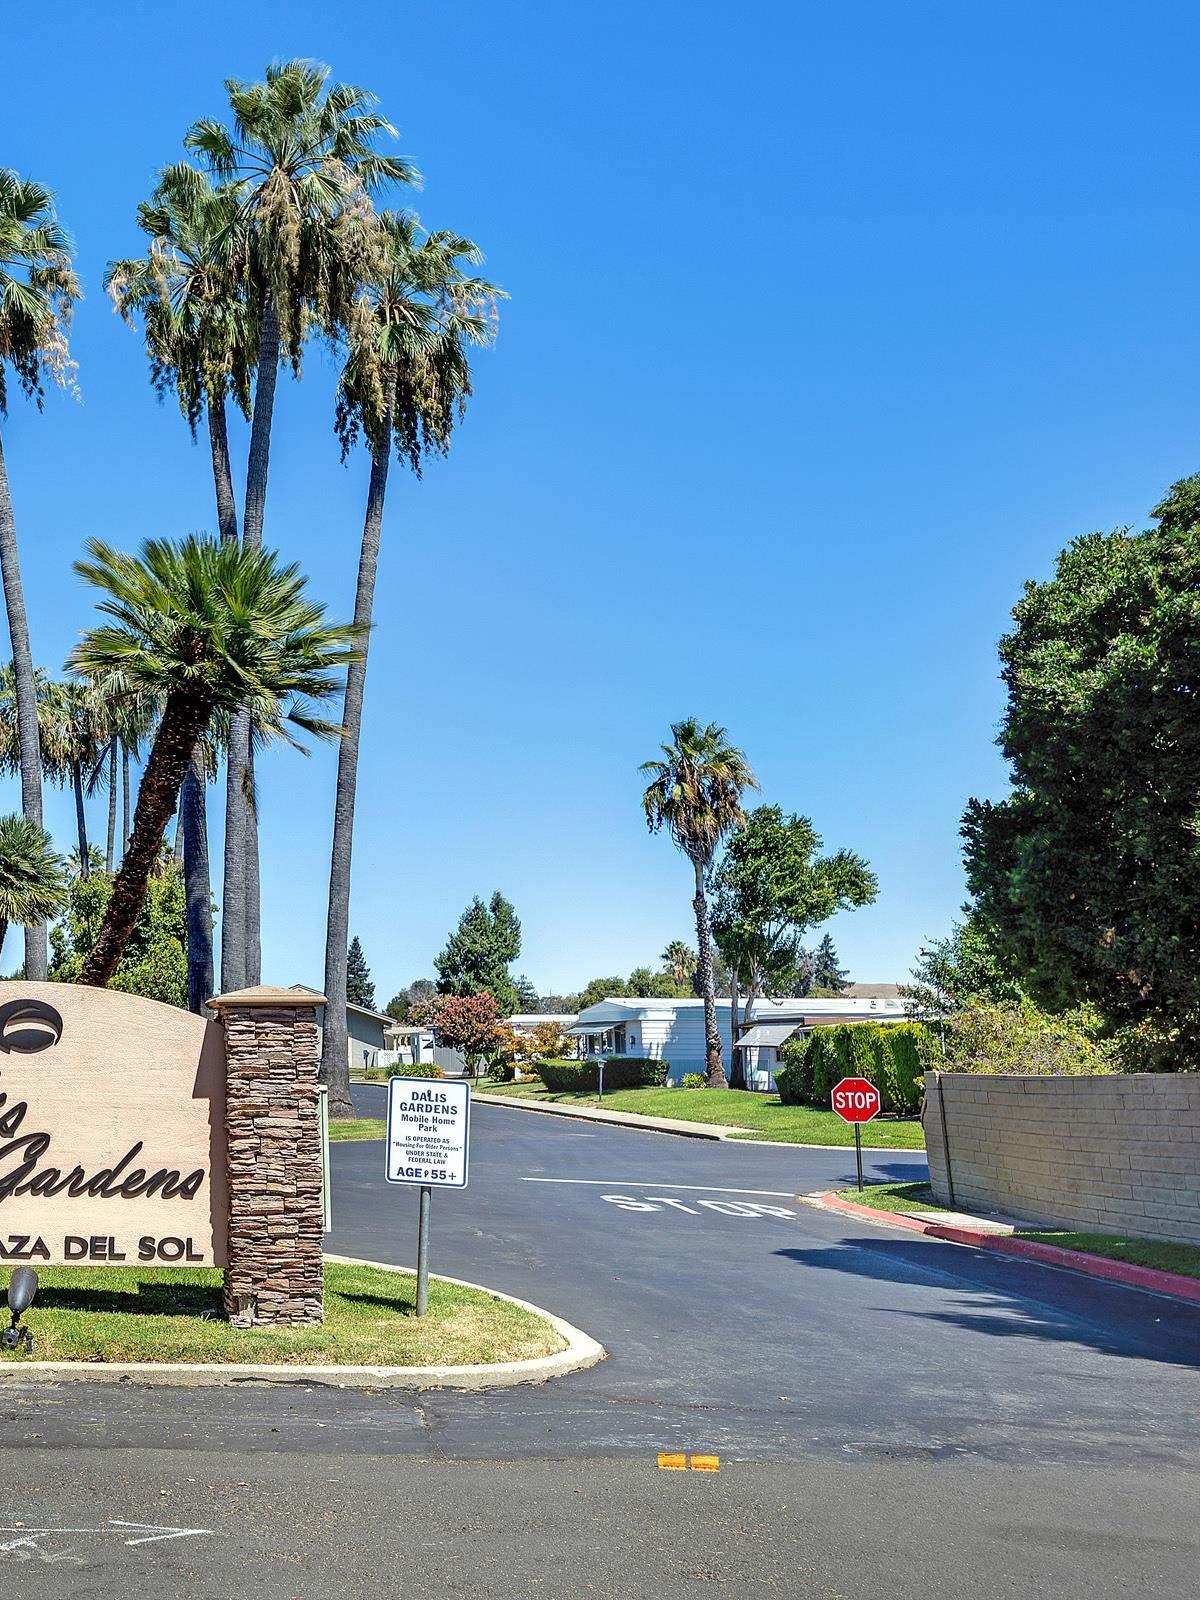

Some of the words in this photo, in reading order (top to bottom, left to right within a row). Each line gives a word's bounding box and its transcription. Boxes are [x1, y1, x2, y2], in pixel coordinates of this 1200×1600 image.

[411, 1091, 447, 1103] DALIS
[836, 1092, 876, 1109] STOP
[400, 1102, 458, 1115] GARDENS
[401, 1114, 429, 1124] Mobile
[432, 1116, 456, 1125] Home
[418, 1124, 437, 1132] Park
[413, 1136, 441, 1144] OPERATED
[397, 1167, 422, 1178] AGE
[600, 1194, 798, 1221] STOP
[64, 1235, 126, 1261] DEL
[138, 1235, 204, 1262] SOL
